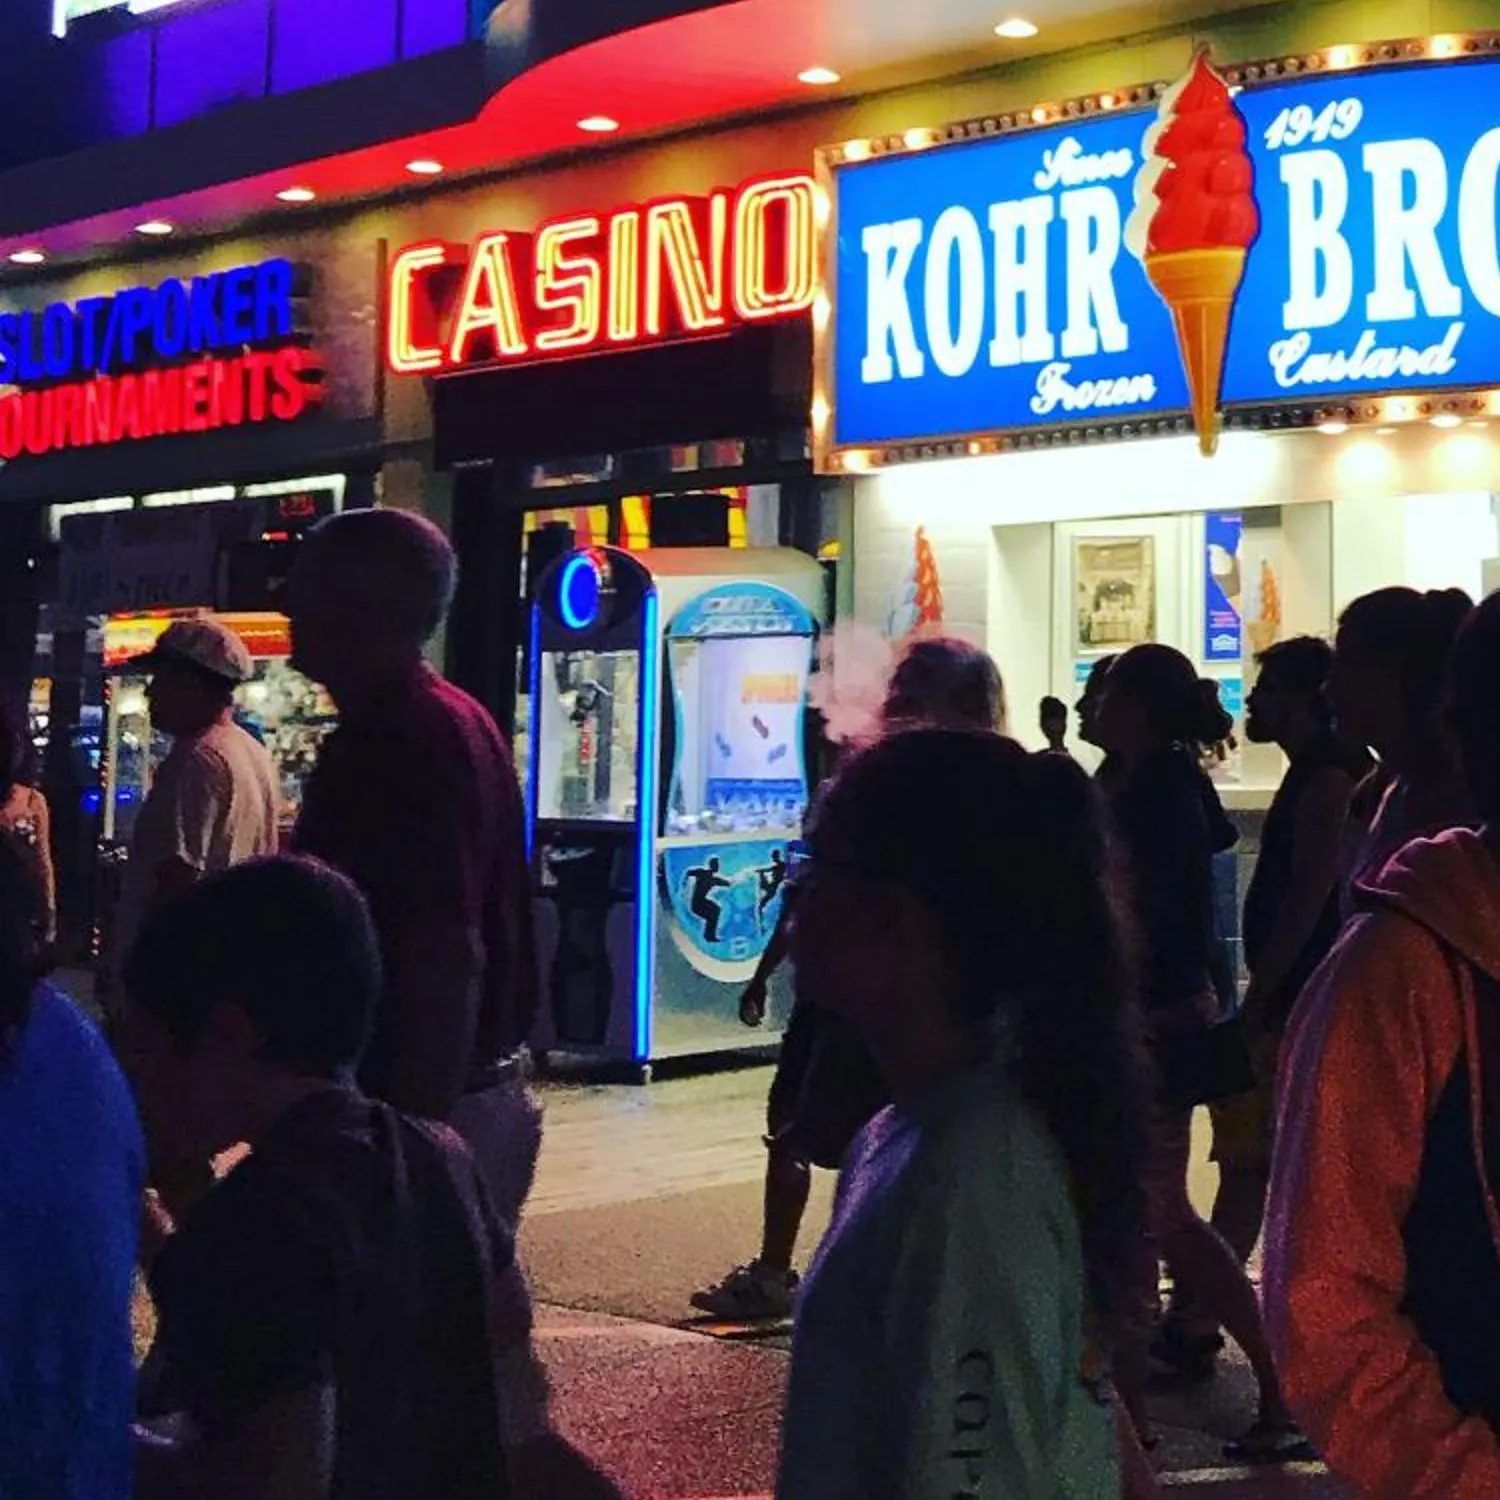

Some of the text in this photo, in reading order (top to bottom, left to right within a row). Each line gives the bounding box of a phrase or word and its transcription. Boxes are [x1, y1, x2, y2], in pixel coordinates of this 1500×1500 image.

[1033, 98, 1364, 190] Since 1919
[0, 257, 296, 385] SLOT/POKER
[386, 172, 820, 377] CASINO
[861, 185, 1129, 384] KOHR
[0, 344, 310, 460] OURNAMENTS
[1030, 323, 1465, 414] Frozen Custard
